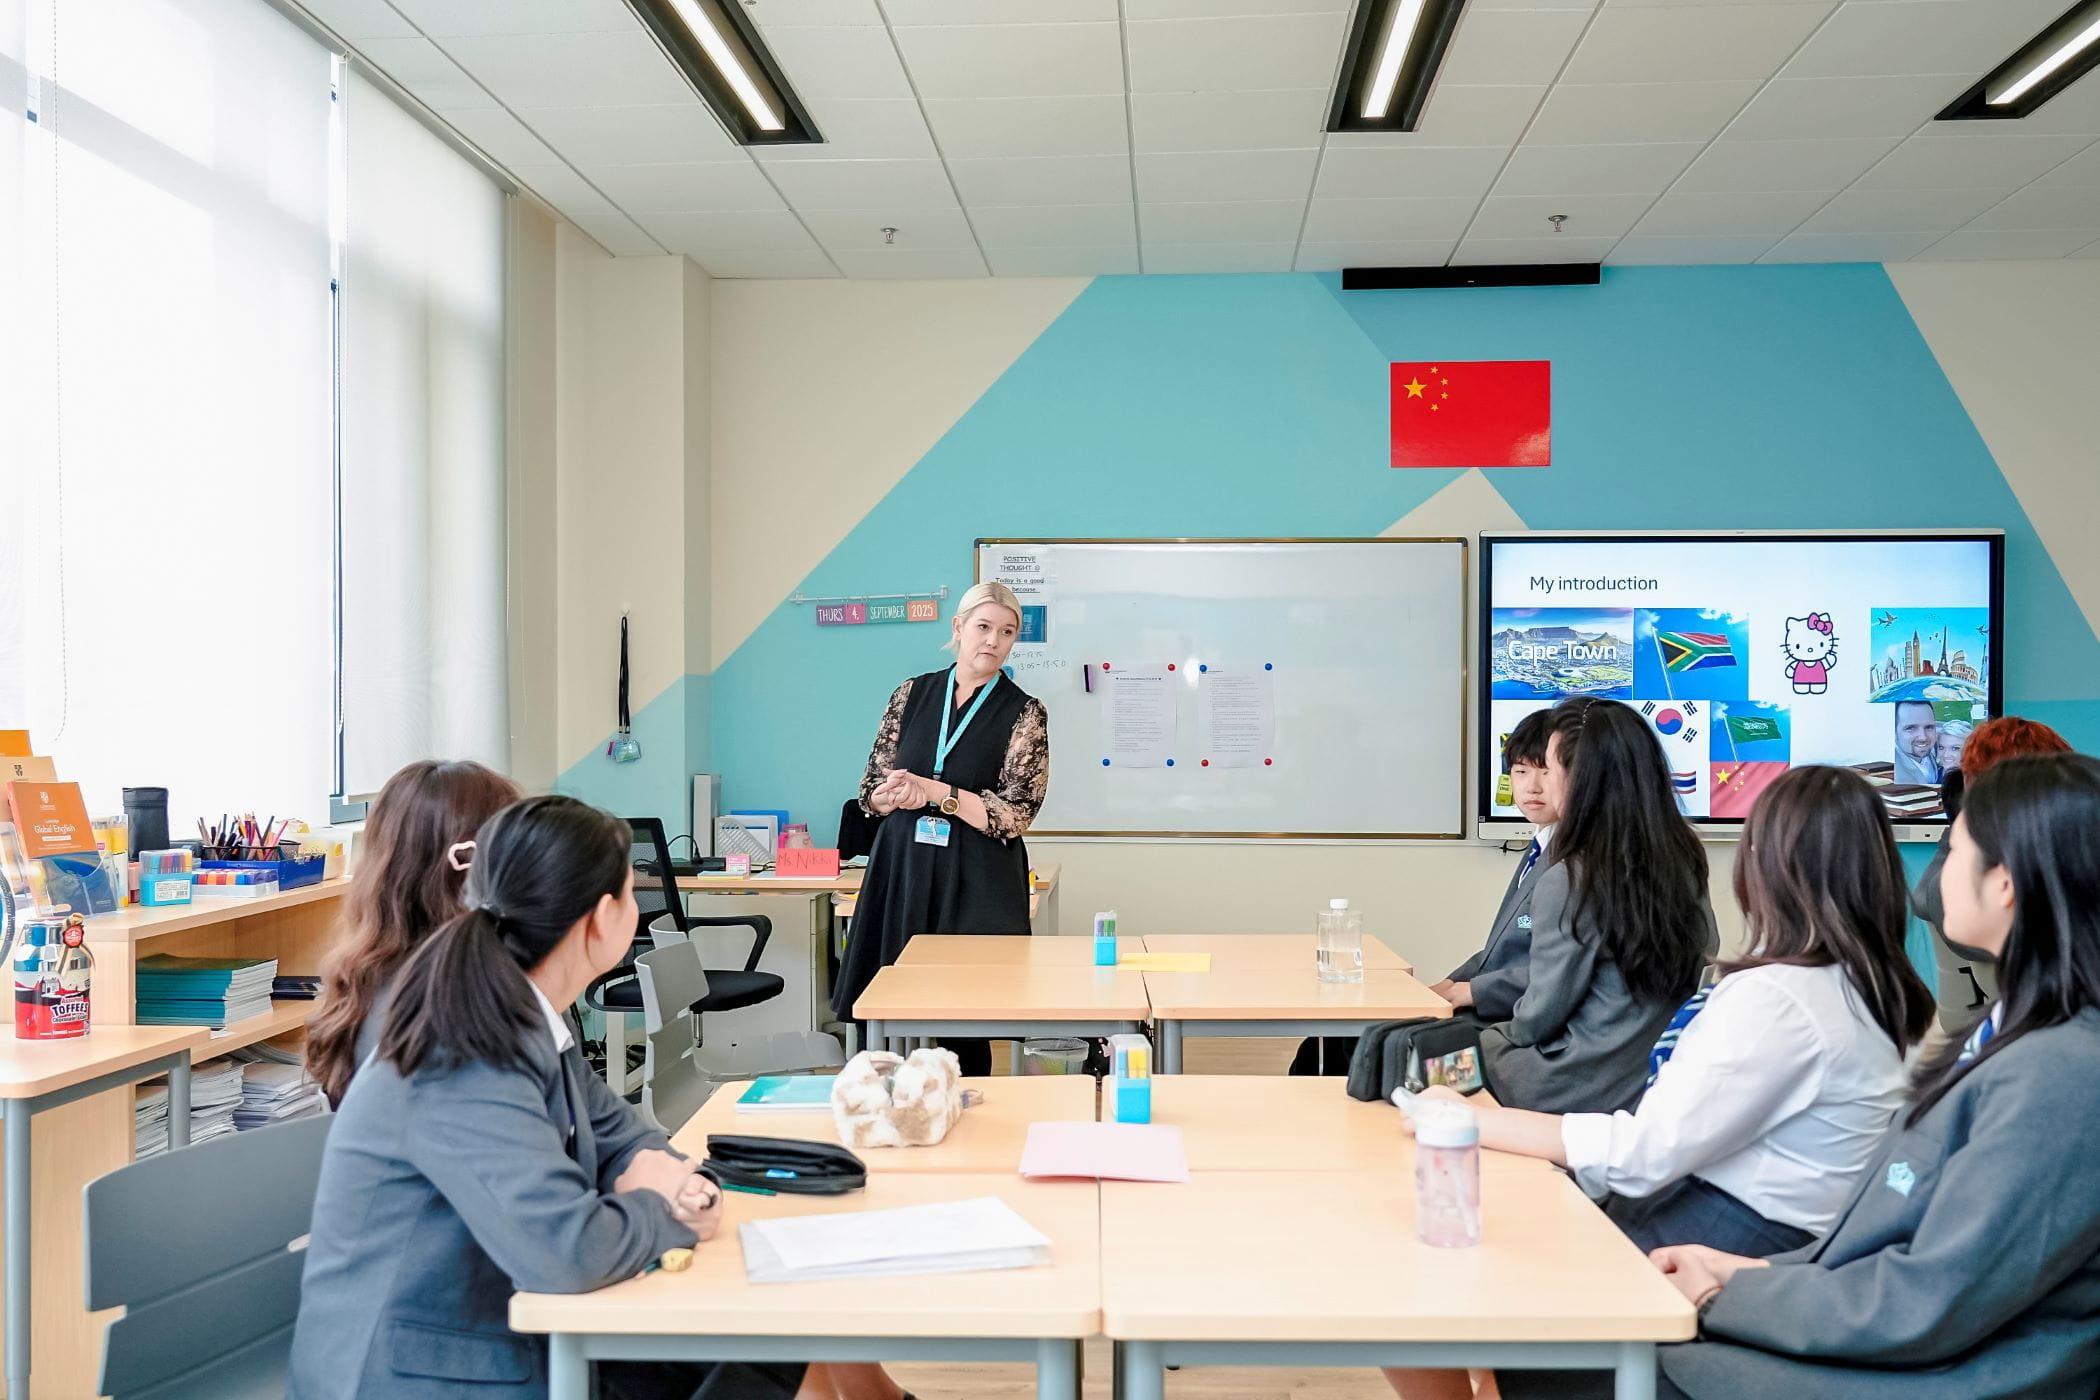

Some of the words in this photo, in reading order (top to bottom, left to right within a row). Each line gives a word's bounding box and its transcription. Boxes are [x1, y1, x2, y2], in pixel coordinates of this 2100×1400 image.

[1530, 576, 1554, 593] My
[1558, 576, 1658, 590] introduction
[818, 608, 843, 622] THURS
[870, 605, 905, 619] SEPTEMBER
[911, 604, 934, 617] 2025
[1508, 640, 1558, 666] Cape
[1562, 640, 1617, 660] Town
[34, 825, 52, 833] Global
[53, 824, 76, 834] English
[797, 850, 832, 870] Nikki
[52, 1003, 88, 1016] TOFFEES
